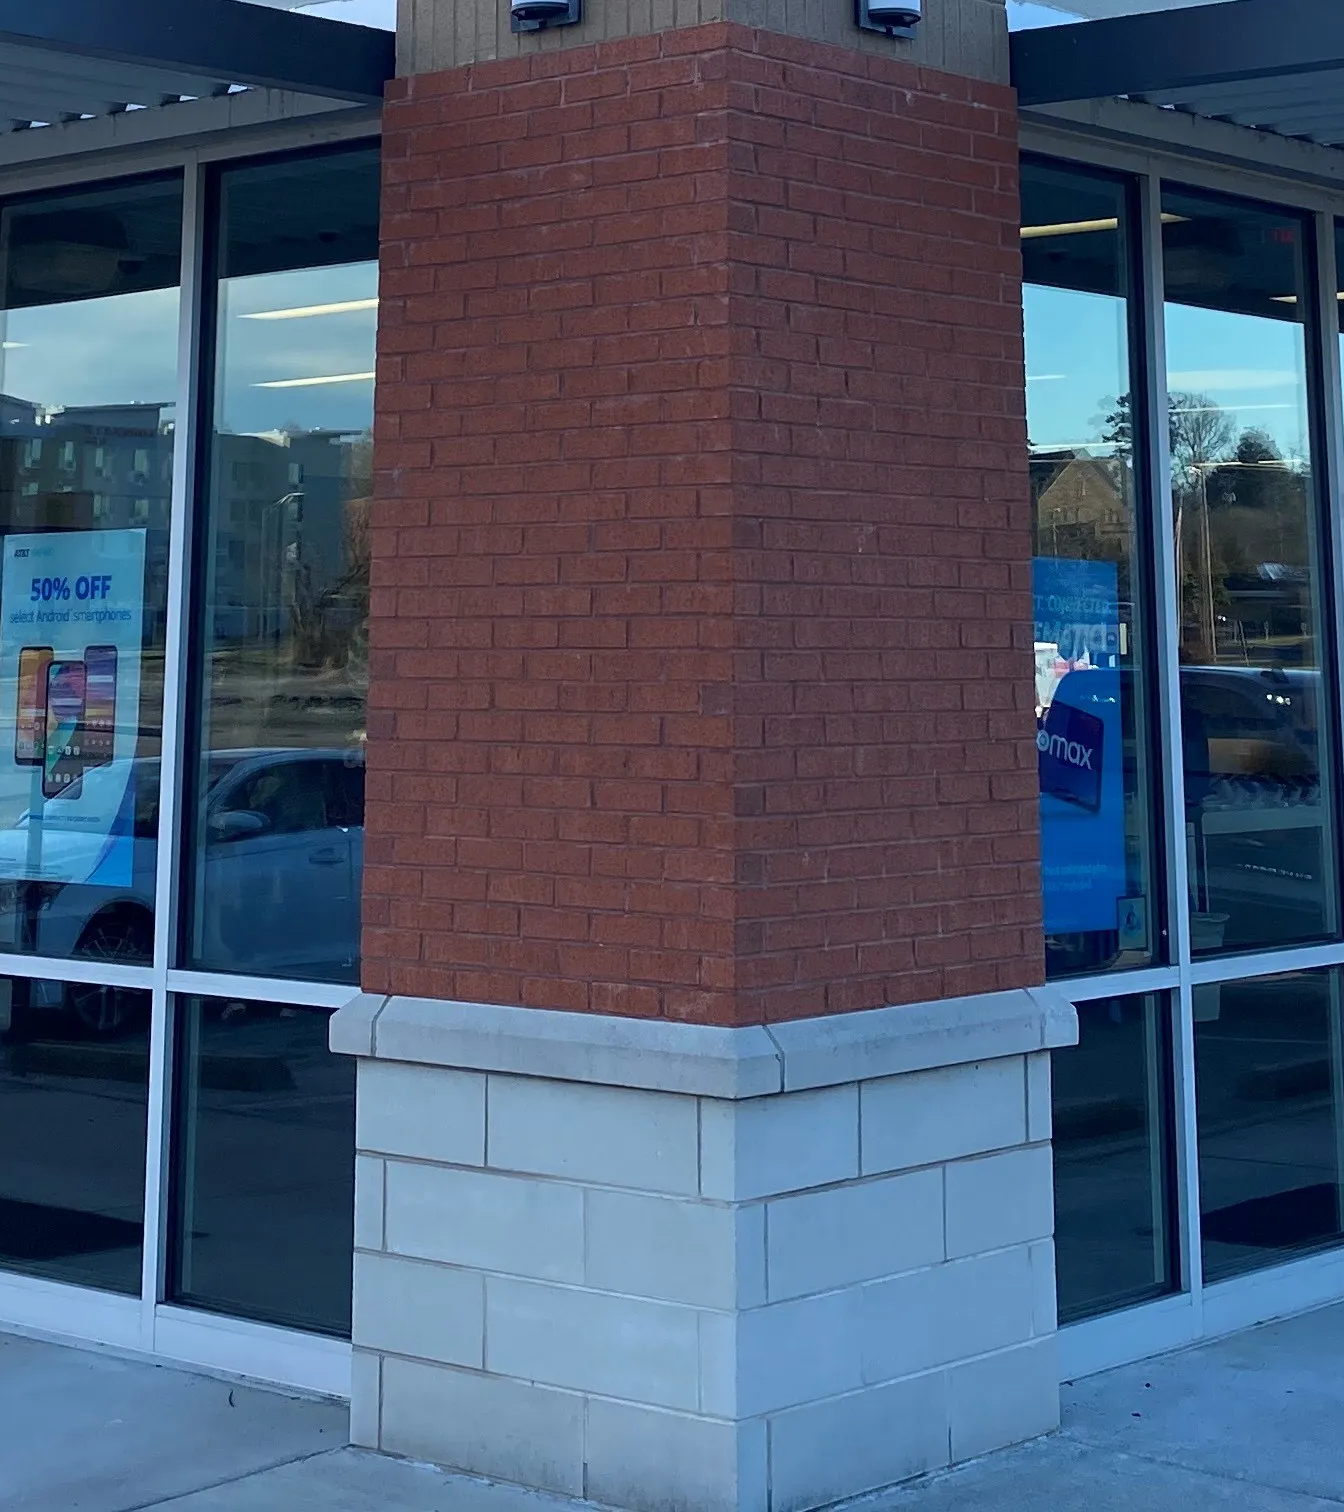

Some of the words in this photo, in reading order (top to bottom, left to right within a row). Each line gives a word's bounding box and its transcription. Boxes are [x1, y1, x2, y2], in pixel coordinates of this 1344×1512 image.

[30, 577, 71, 601] 50%
[75, 575, 112, 600] OFF
[73, 606, 132, 624] smartphones
